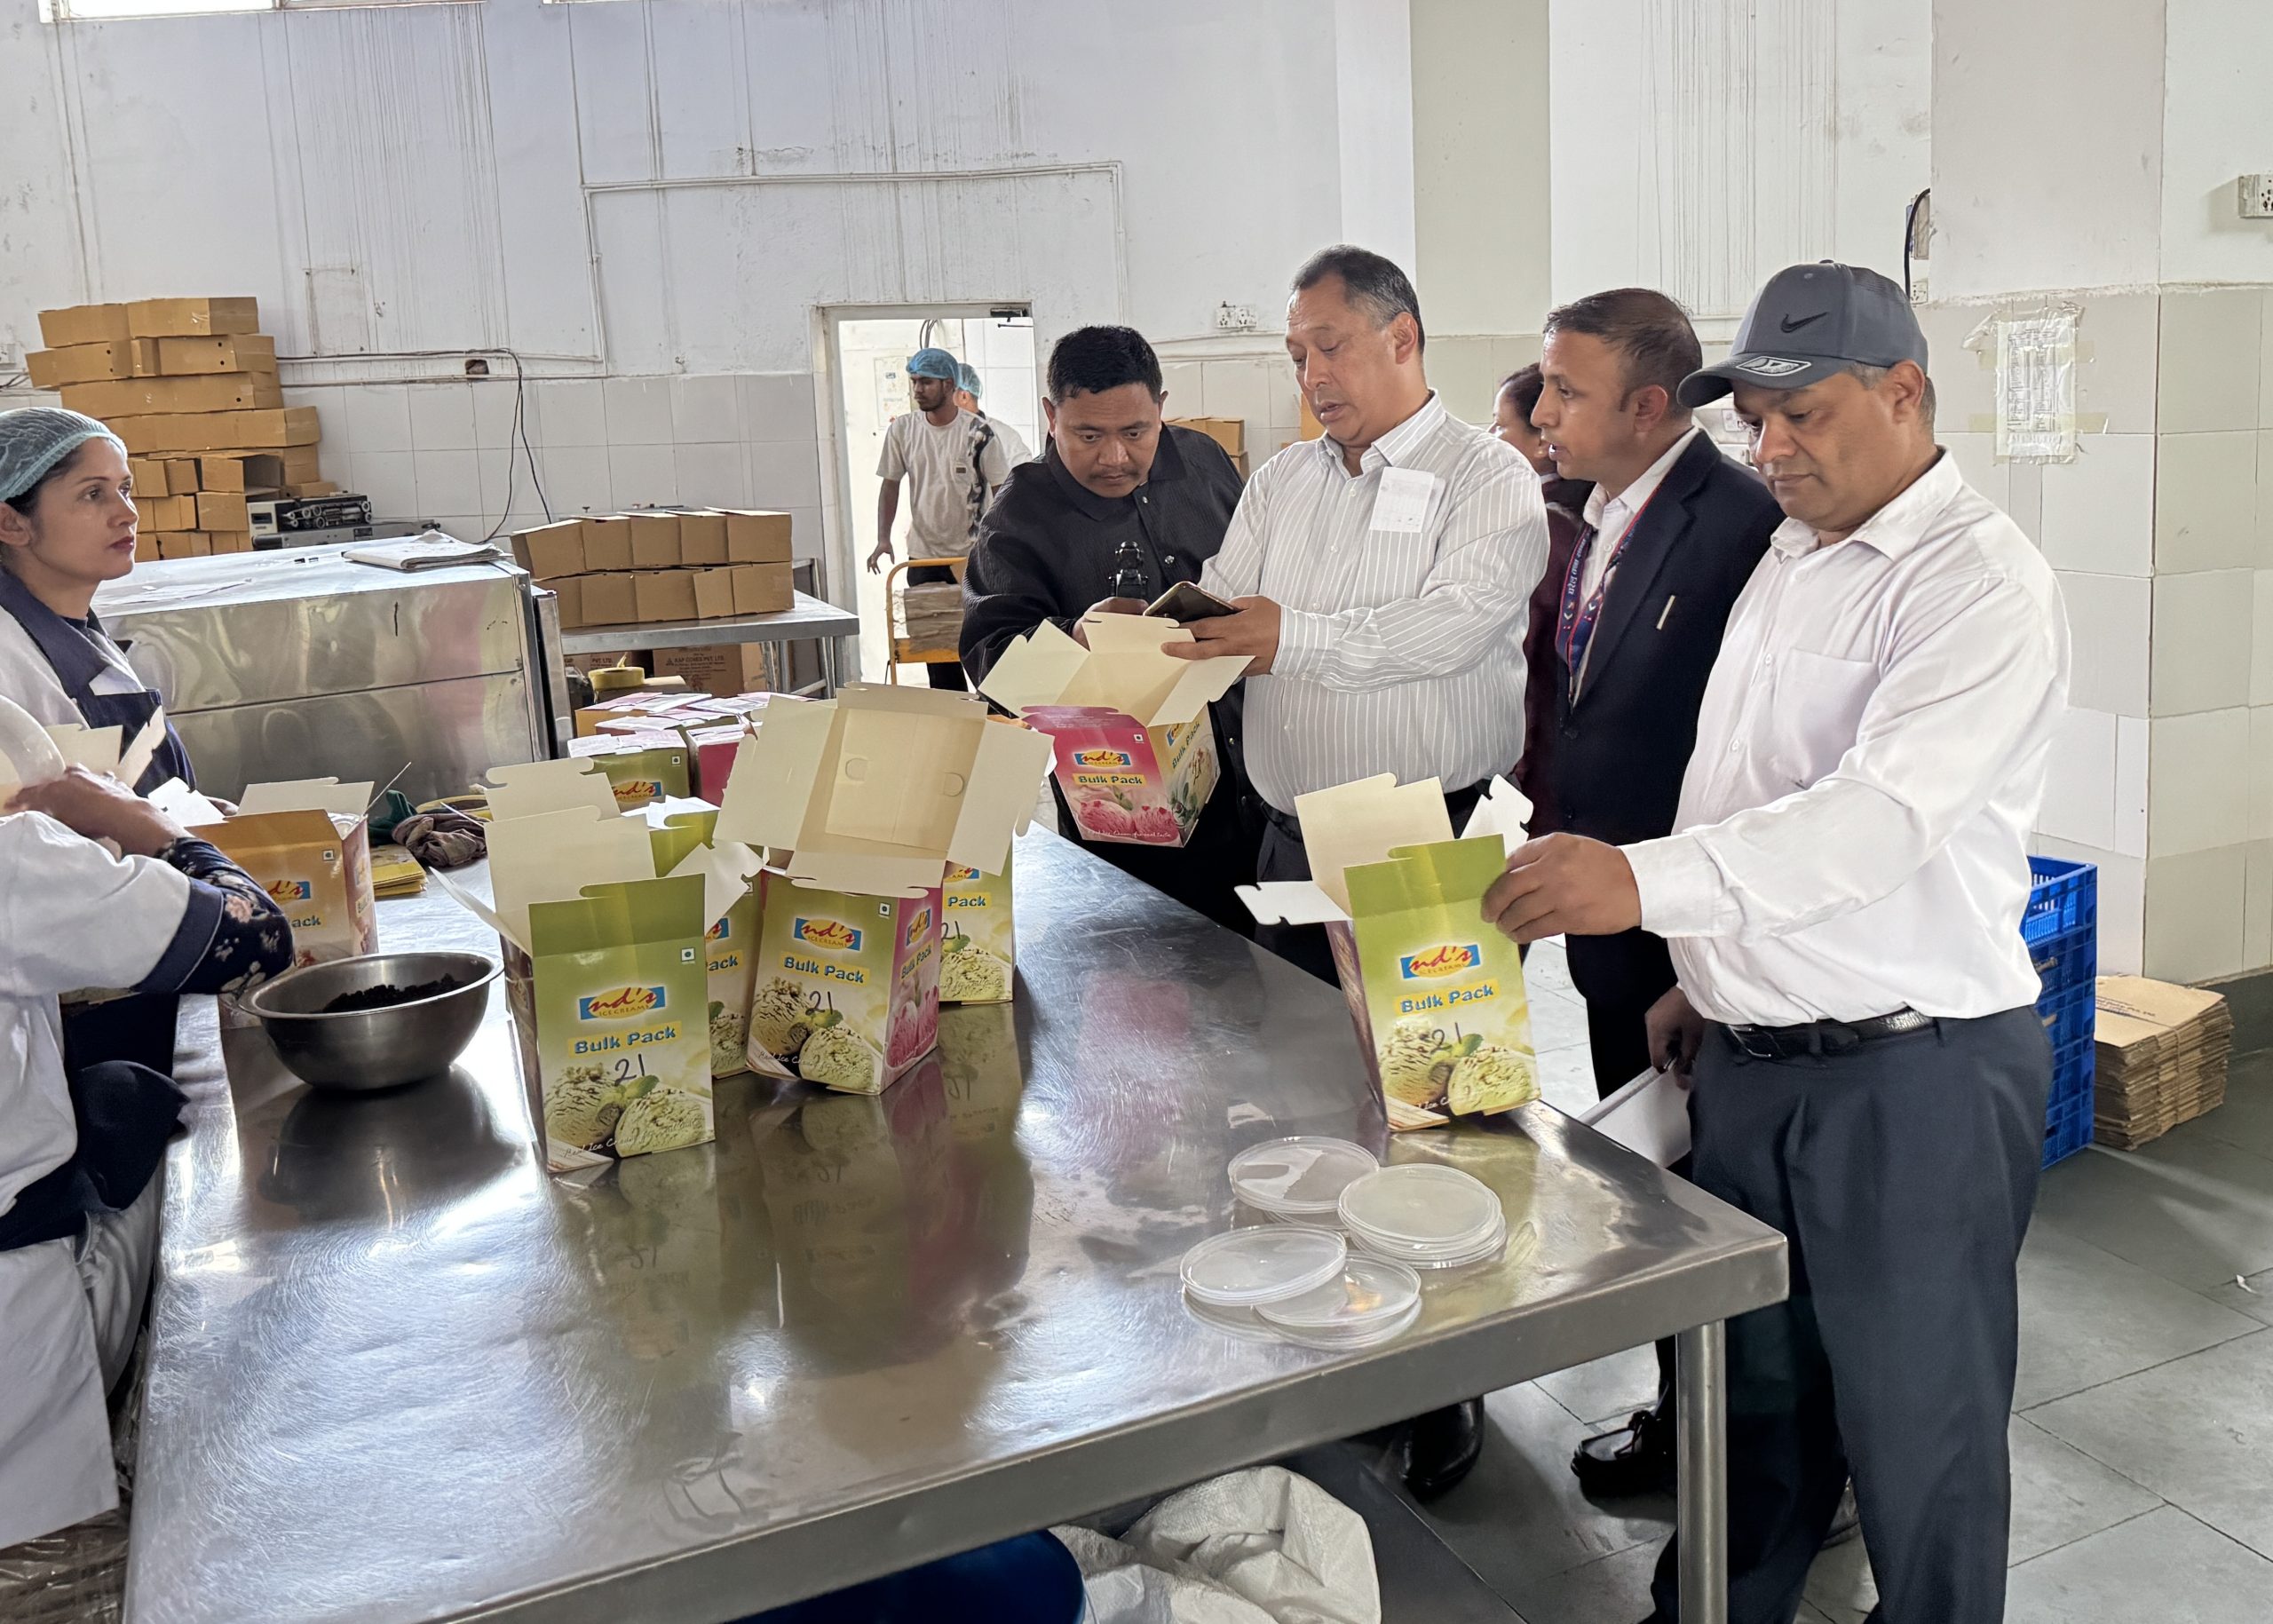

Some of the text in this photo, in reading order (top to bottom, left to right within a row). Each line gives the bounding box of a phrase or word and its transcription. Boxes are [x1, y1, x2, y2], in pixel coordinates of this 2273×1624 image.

[1172, 746, 1186, 769] Bulk
[1186, 721, 1200, 746] Pack
[267, 880, 304, 896] d's
[947, 895, 986, 907] Pack
[291, 915, 321, 928] ack
[801, 922, 855, 943] nd's
[941, 920, 961, 942] 21
[706, 955, 739, 971] ack
[916, 945, 931, 965] Pack
[1409, 946, 1472, 970] nd's
[784, 956, 864, 984] Bulk Pack
[587, 987, 658, 1012] nd's
[805, 990, 833, 1016] 21
[1400, 984, 1493, 1012] Bulk Pack
[574, 1026, 677, 1054] Bulk Pack
[1430, 1022, 1462, 1054] 21
[614, 1053, 645, 1087] 21
